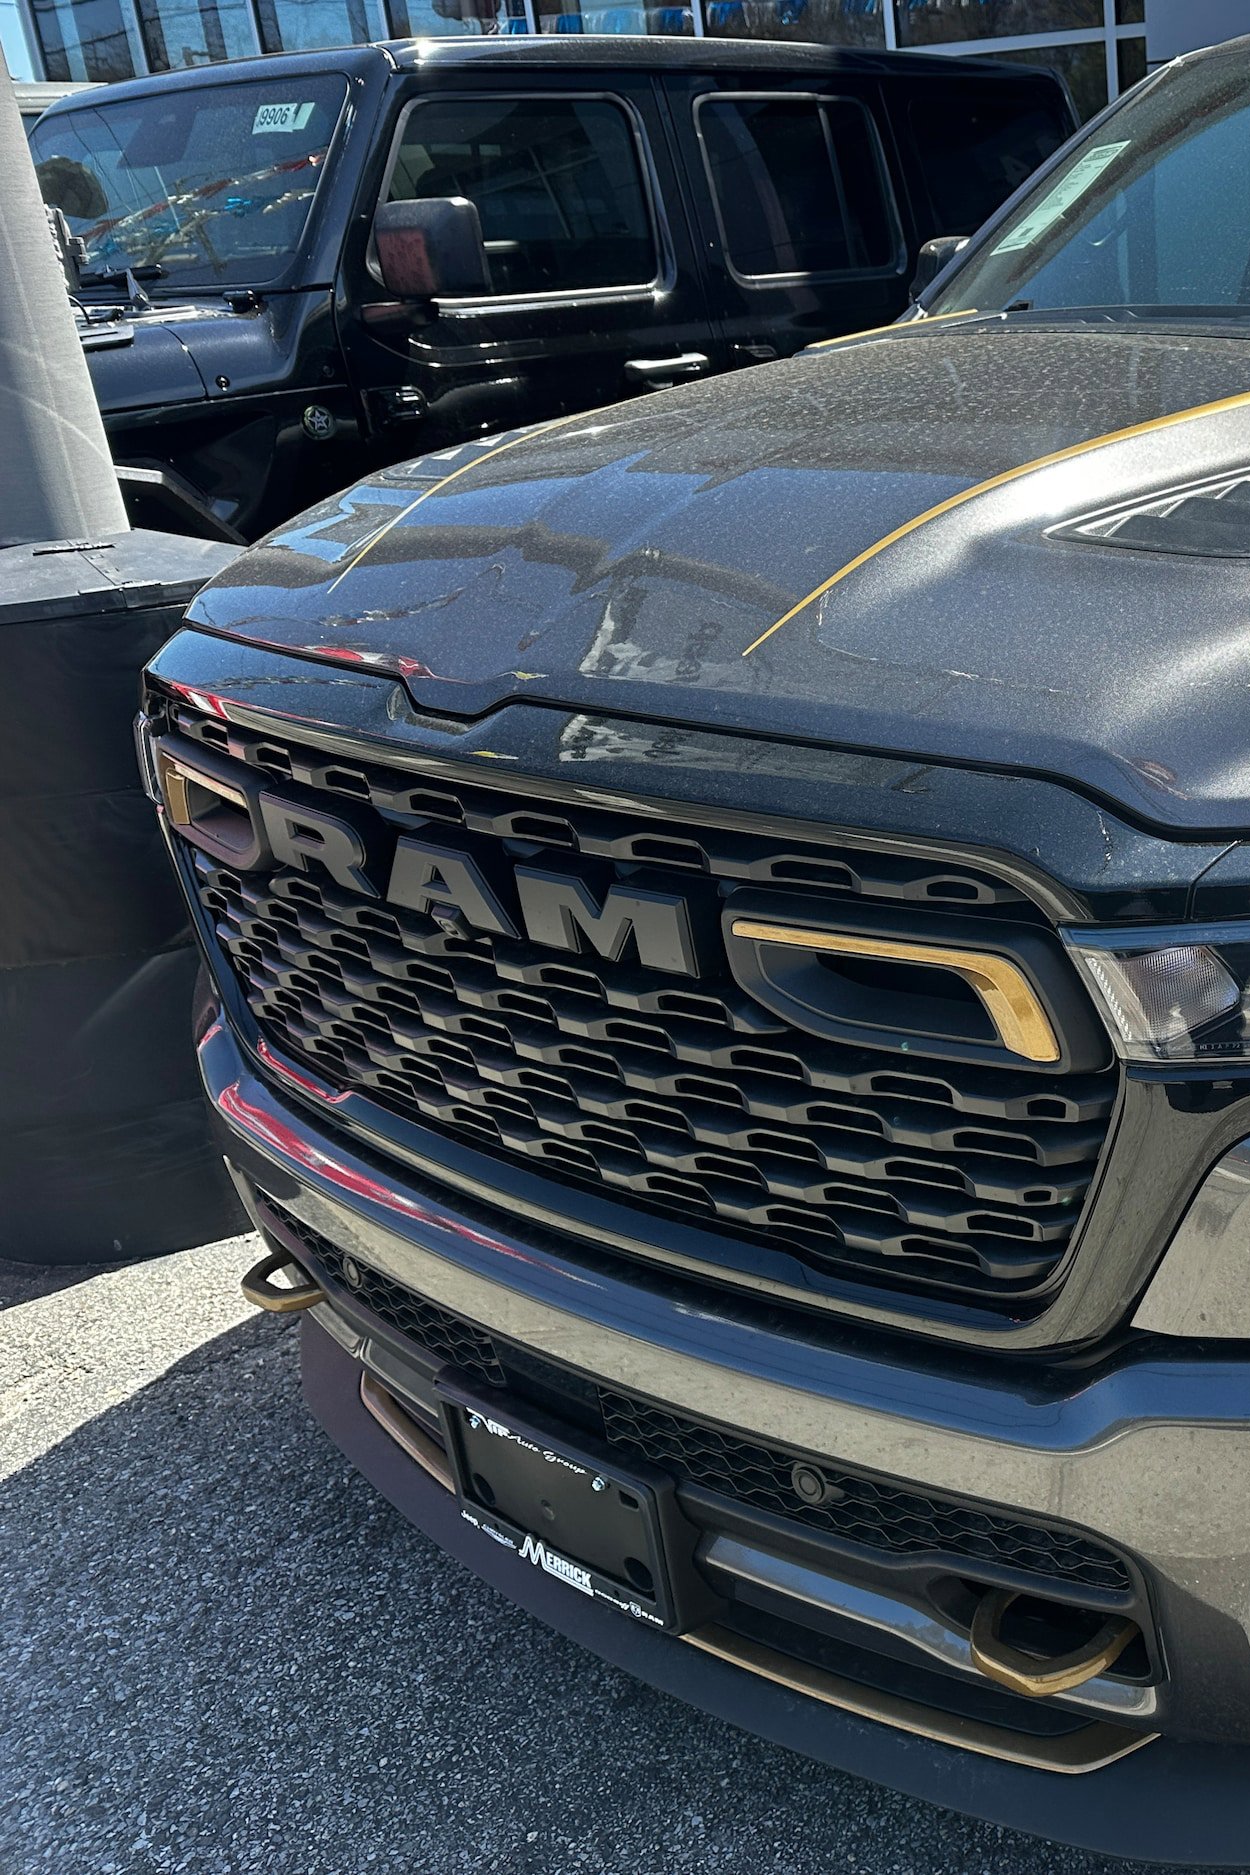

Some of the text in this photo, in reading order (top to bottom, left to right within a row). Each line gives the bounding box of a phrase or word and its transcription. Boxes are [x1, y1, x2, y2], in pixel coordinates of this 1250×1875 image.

[259, 790, 700, 978] RAM
[508, 1434, 541, 1453] Auto
[542, 1450, 587, 1475] Group
[518, 1533, 594, 1596] MERRICK
